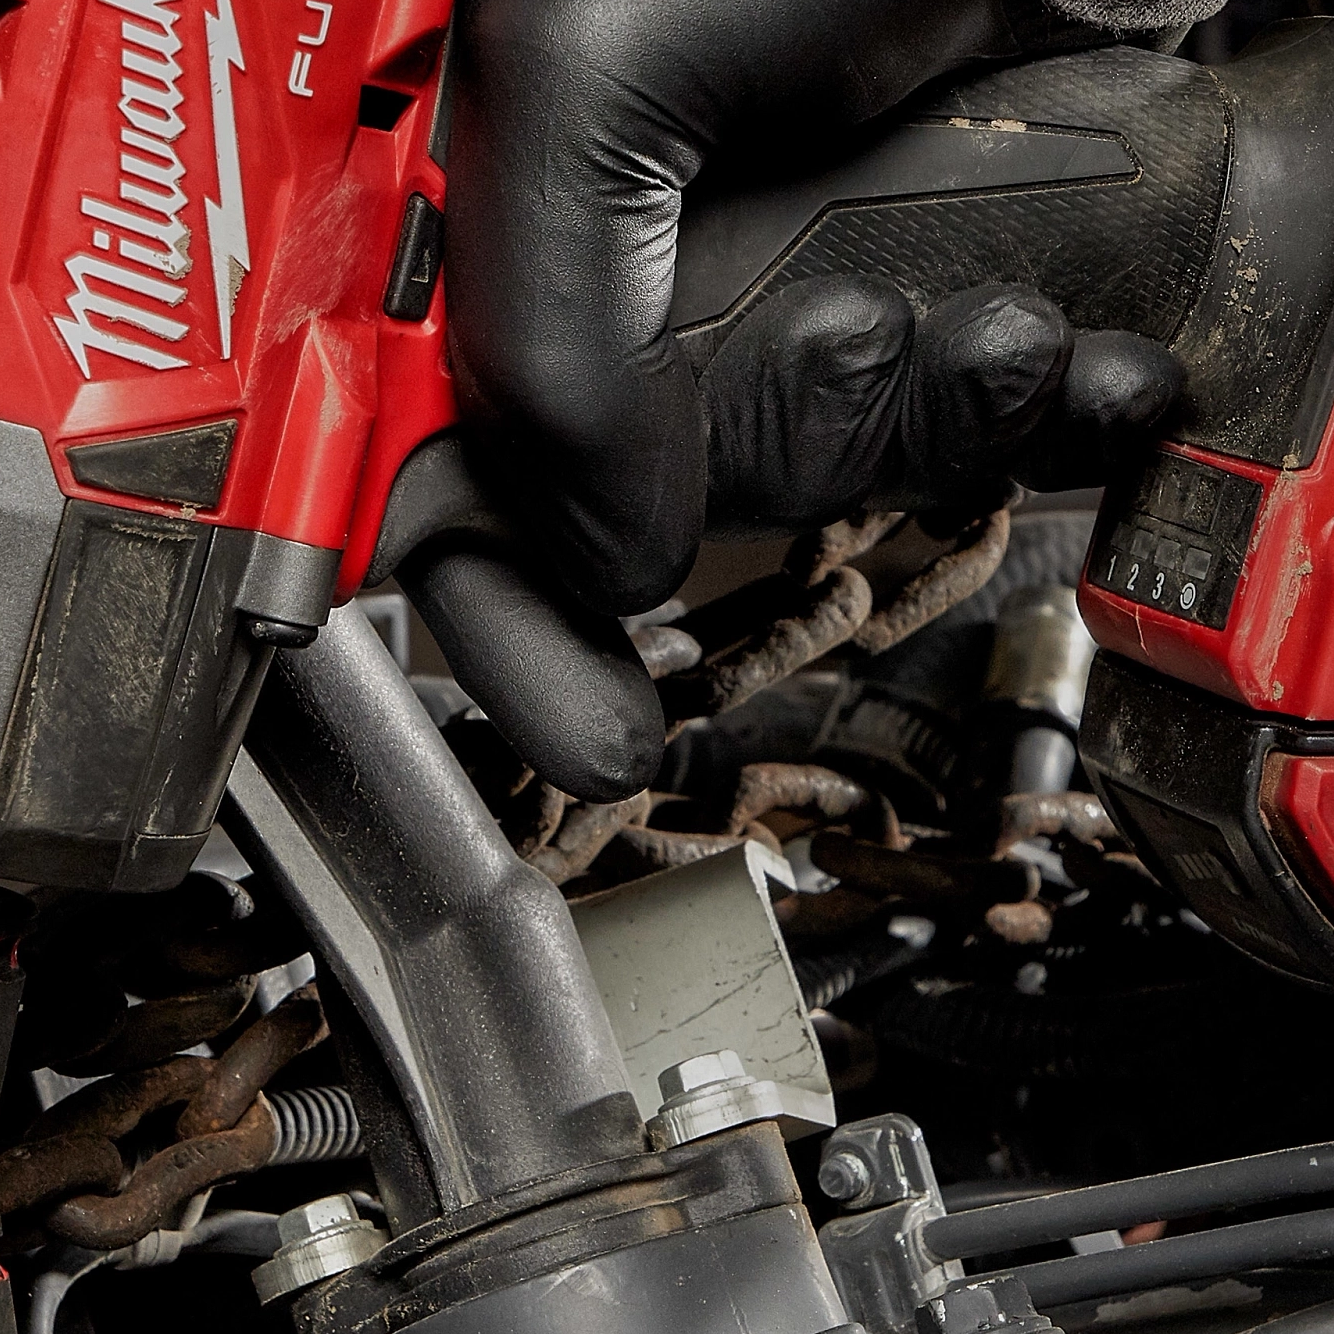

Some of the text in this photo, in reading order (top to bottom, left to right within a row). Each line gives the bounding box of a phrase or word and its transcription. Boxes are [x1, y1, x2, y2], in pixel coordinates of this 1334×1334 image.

[1107, 555, 1166, 600] 1 2 3
